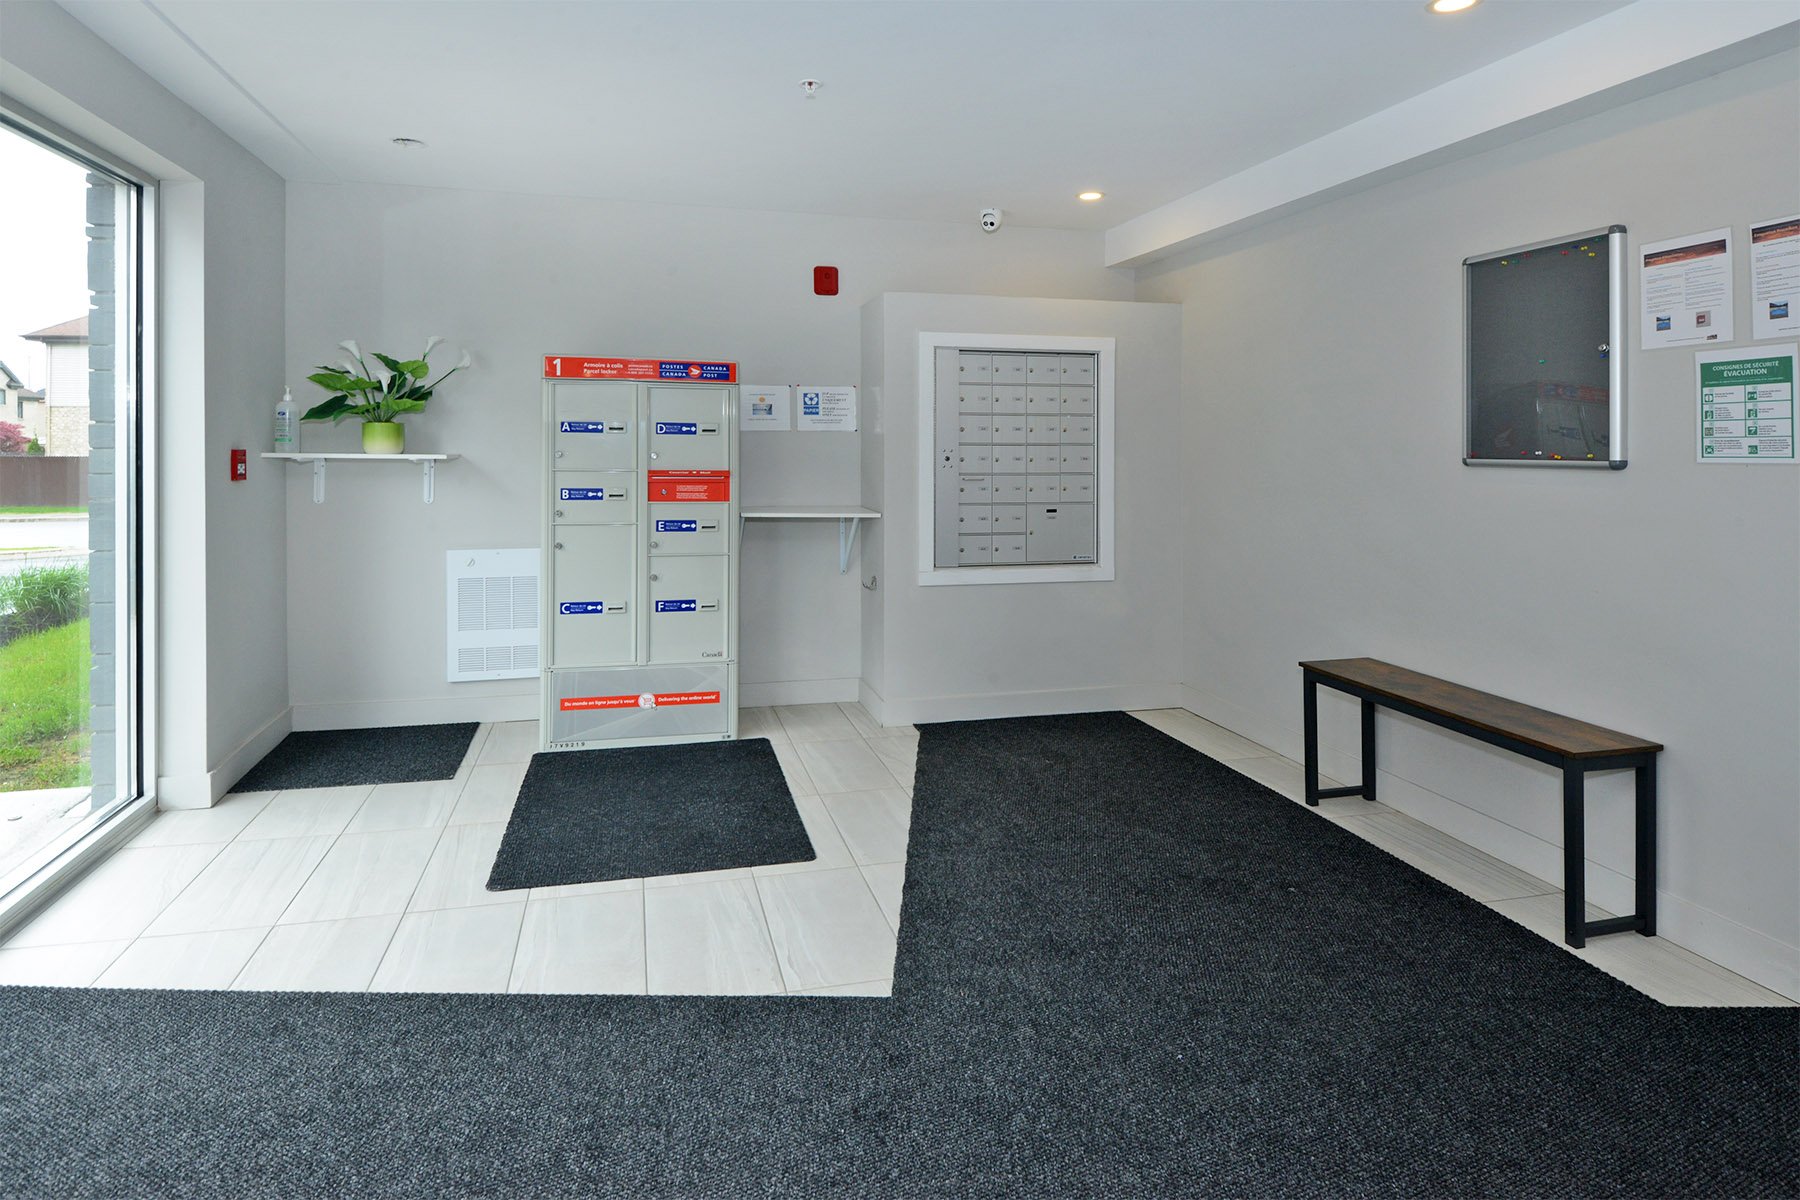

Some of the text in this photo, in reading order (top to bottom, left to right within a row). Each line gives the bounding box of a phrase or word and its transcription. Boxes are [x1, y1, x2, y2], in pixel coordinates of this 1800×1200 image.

[553, 358, 561, 376] 1
[583, 361, 606, 369] Armoire
[1713, 363, 1743, 371] CONSIGNES
[562, 422, 570, 431] A
[657, 423, 666, 433] D
[562, 489, 569, 499] B
[658, 521, 665, 531] E
[561, 603, 570, 613] C
[658, 602, 664, 611] F
